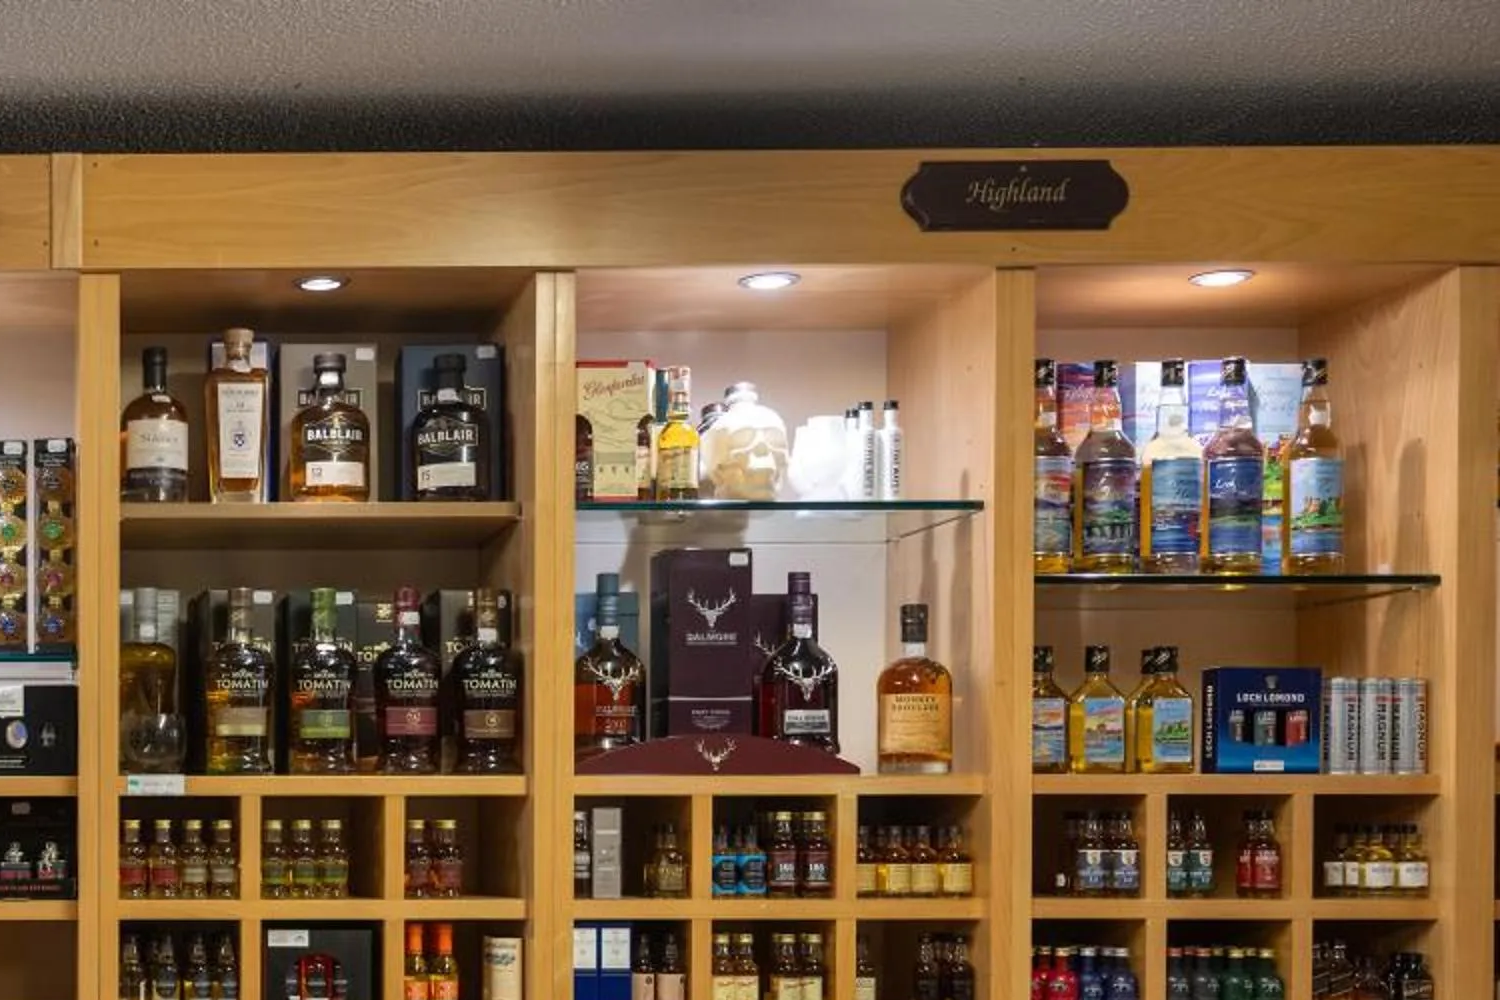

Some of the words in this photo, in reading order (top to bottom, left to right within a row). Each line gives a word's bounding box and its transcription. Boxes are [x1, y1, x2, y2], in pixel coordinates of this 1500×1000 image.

[966, 177, 1071, 212] Highland
[307, 428, 362, 441] BALBLAIR
[417, 430, 473, 445] BALBLAIR
[216, 679, 269, 691] TOMATIN
[298, 679, 351, 691] TOMATIN
[387, 679, 440, 691] TOMATIN
[463, 679, 517, 691] TOMATIN
[1236, 693, 1262, 703] LOCH
[1264, 693, 1305, 703] LOMOND
[1347, 703, 1357, 762] MAGNUM
[1377, 703, 1387, 762] MAGNUM
